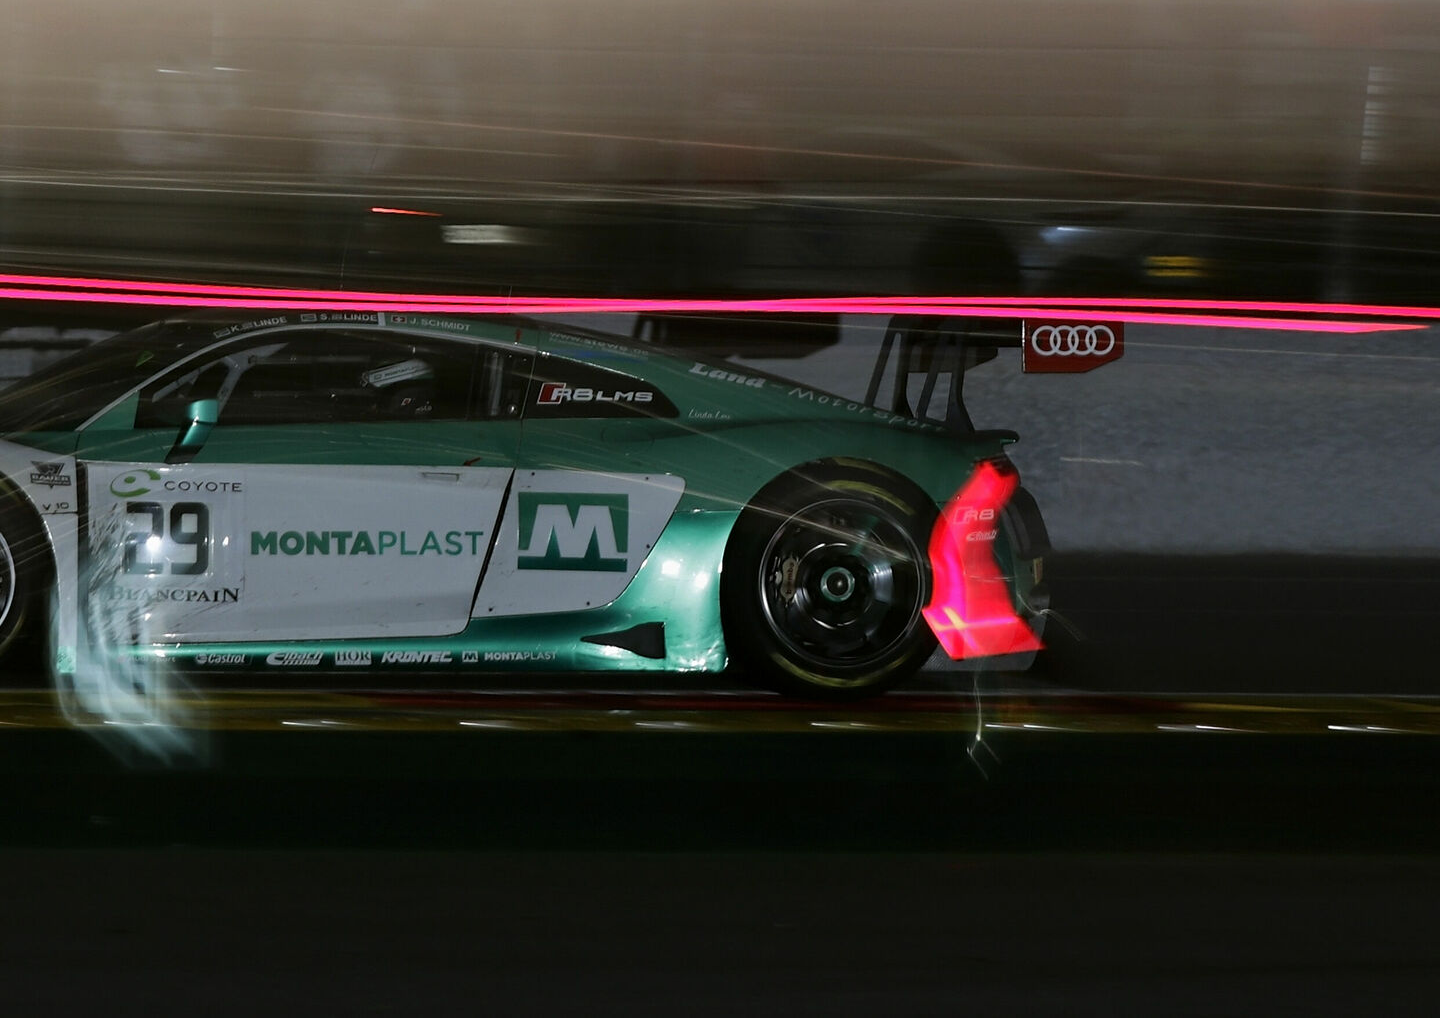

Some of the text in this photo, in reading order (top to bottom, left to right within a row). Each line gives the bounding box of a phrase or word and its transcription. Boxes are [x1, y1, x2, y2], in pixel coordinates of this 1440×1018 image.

[253, 316, 288, 328] LINDE
[343, 313, 378, 322] LINDE
[421, 318, 471, 332] SCHMIDT
[688, 362, 766, 389] Land
[550, 388, 654, 402] R8 LMS
[163, 480, 243, 492] COYOTE
[124, 501, 210, 575] 29
[250, 530, 484, 556] MONTAPLAST
[109, 587, 240, 603] BLANCPAIN
[208, 653, 247, 664] Castrol
[381, 650, 453, 663] KRONTEC
[484, 650, 558, 662] MONTAPLAST
